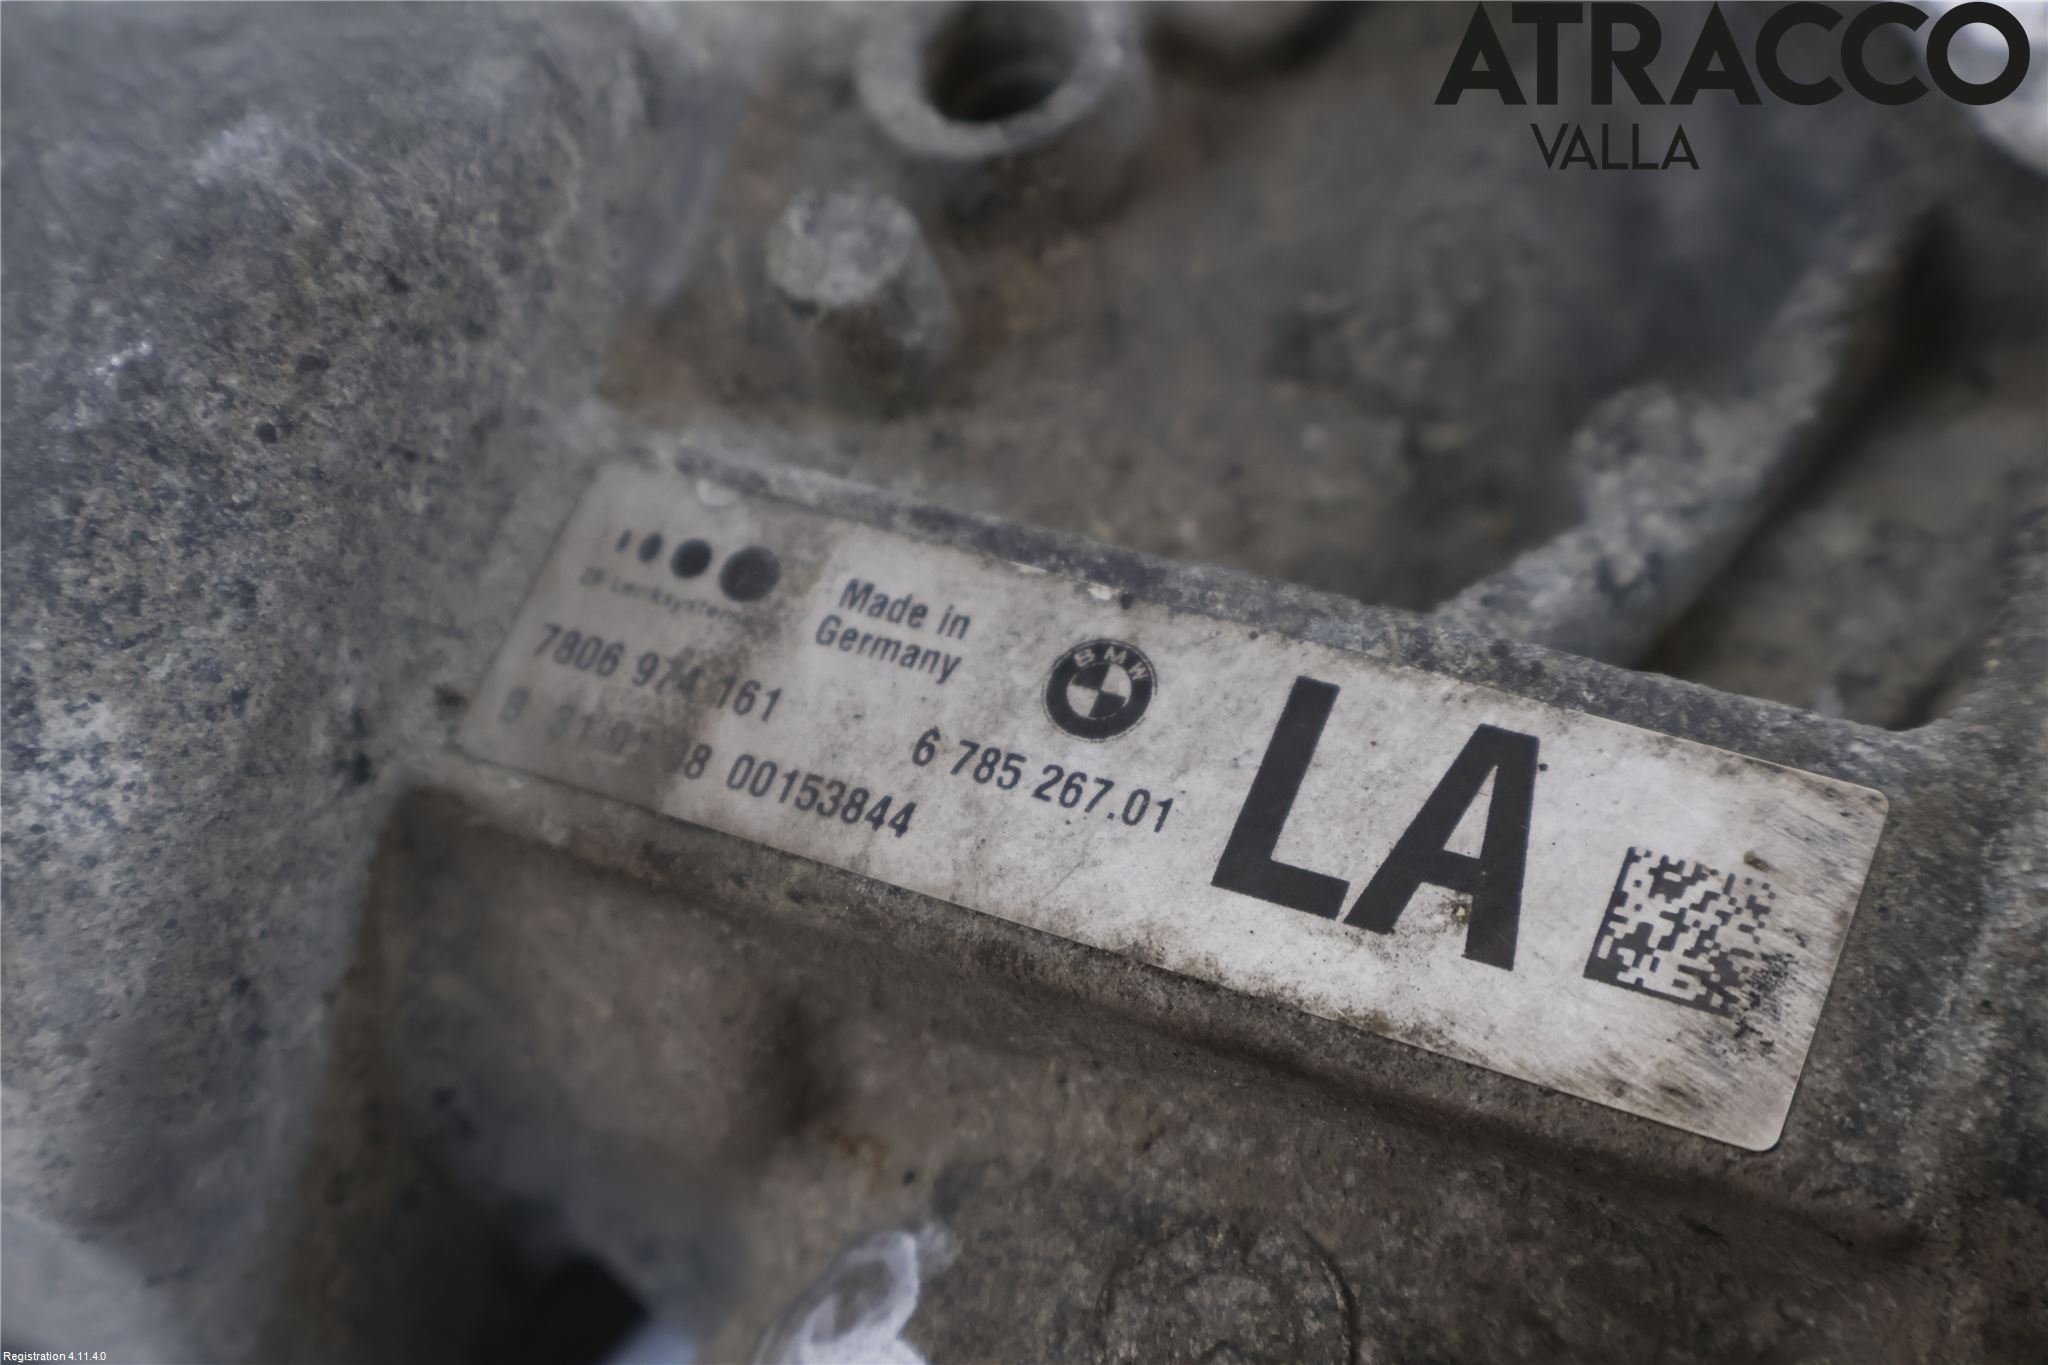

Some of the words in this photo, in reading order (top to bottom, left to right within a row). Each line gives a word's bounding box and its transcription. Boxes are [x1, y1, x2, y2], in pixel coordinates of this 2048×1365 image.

[815, 615, 963, 685] Germany
[839, 578, 929, 629] Made
[936, 604, 972, 641] in
[533, 622, 626, 678] 7806
[715, 674, 784, 723] 161
[726, 753, 917, 839] 00153844
[912, 726, 942, 767] 6
[950, 739, 1027, 790] 785
[1032, 764, 1176, 833] 267.01
[1211, 675, 1540, 971] LA
